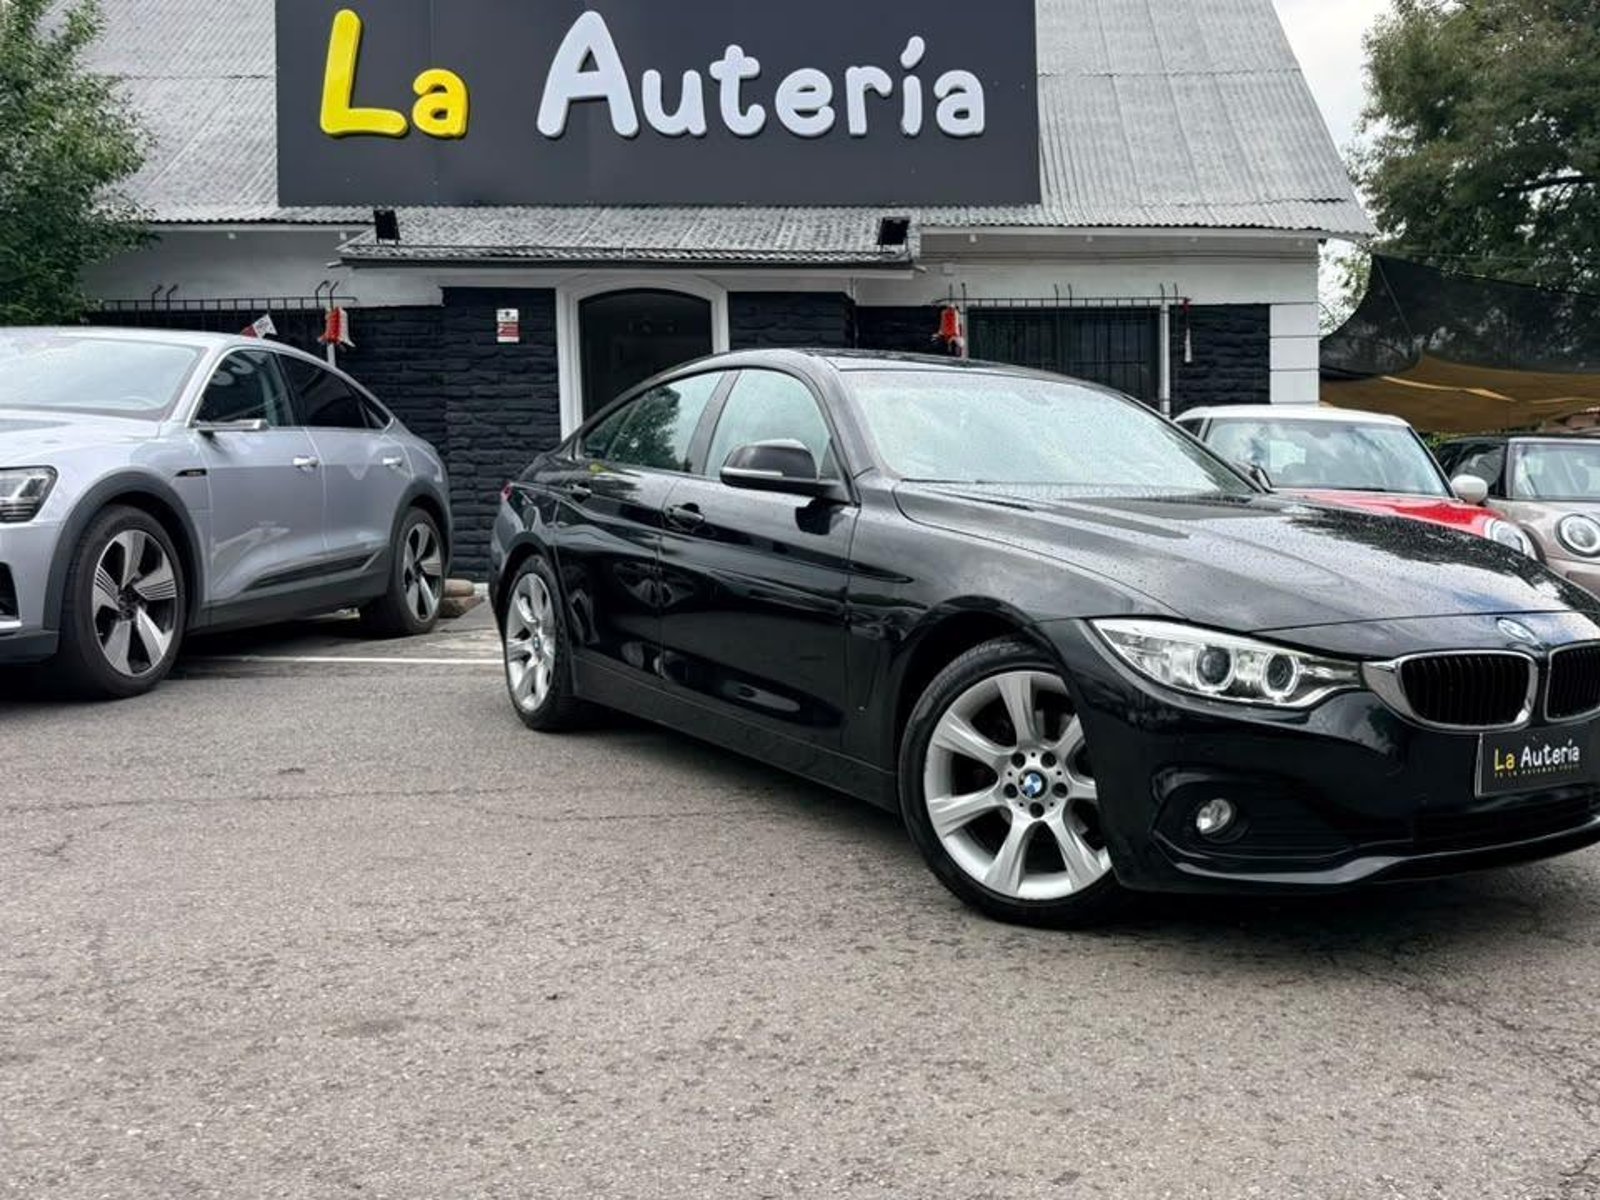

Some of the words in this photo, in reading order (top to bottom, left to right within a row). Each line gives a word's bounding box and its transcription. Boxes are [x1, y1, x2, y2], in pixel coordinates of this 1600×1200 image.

[320, 9, 469, 137] La
[536, 11, 984, 137] Autería
[1494, 748, 1515, 771] La
[1520, 738, 1580, 768] Autería
